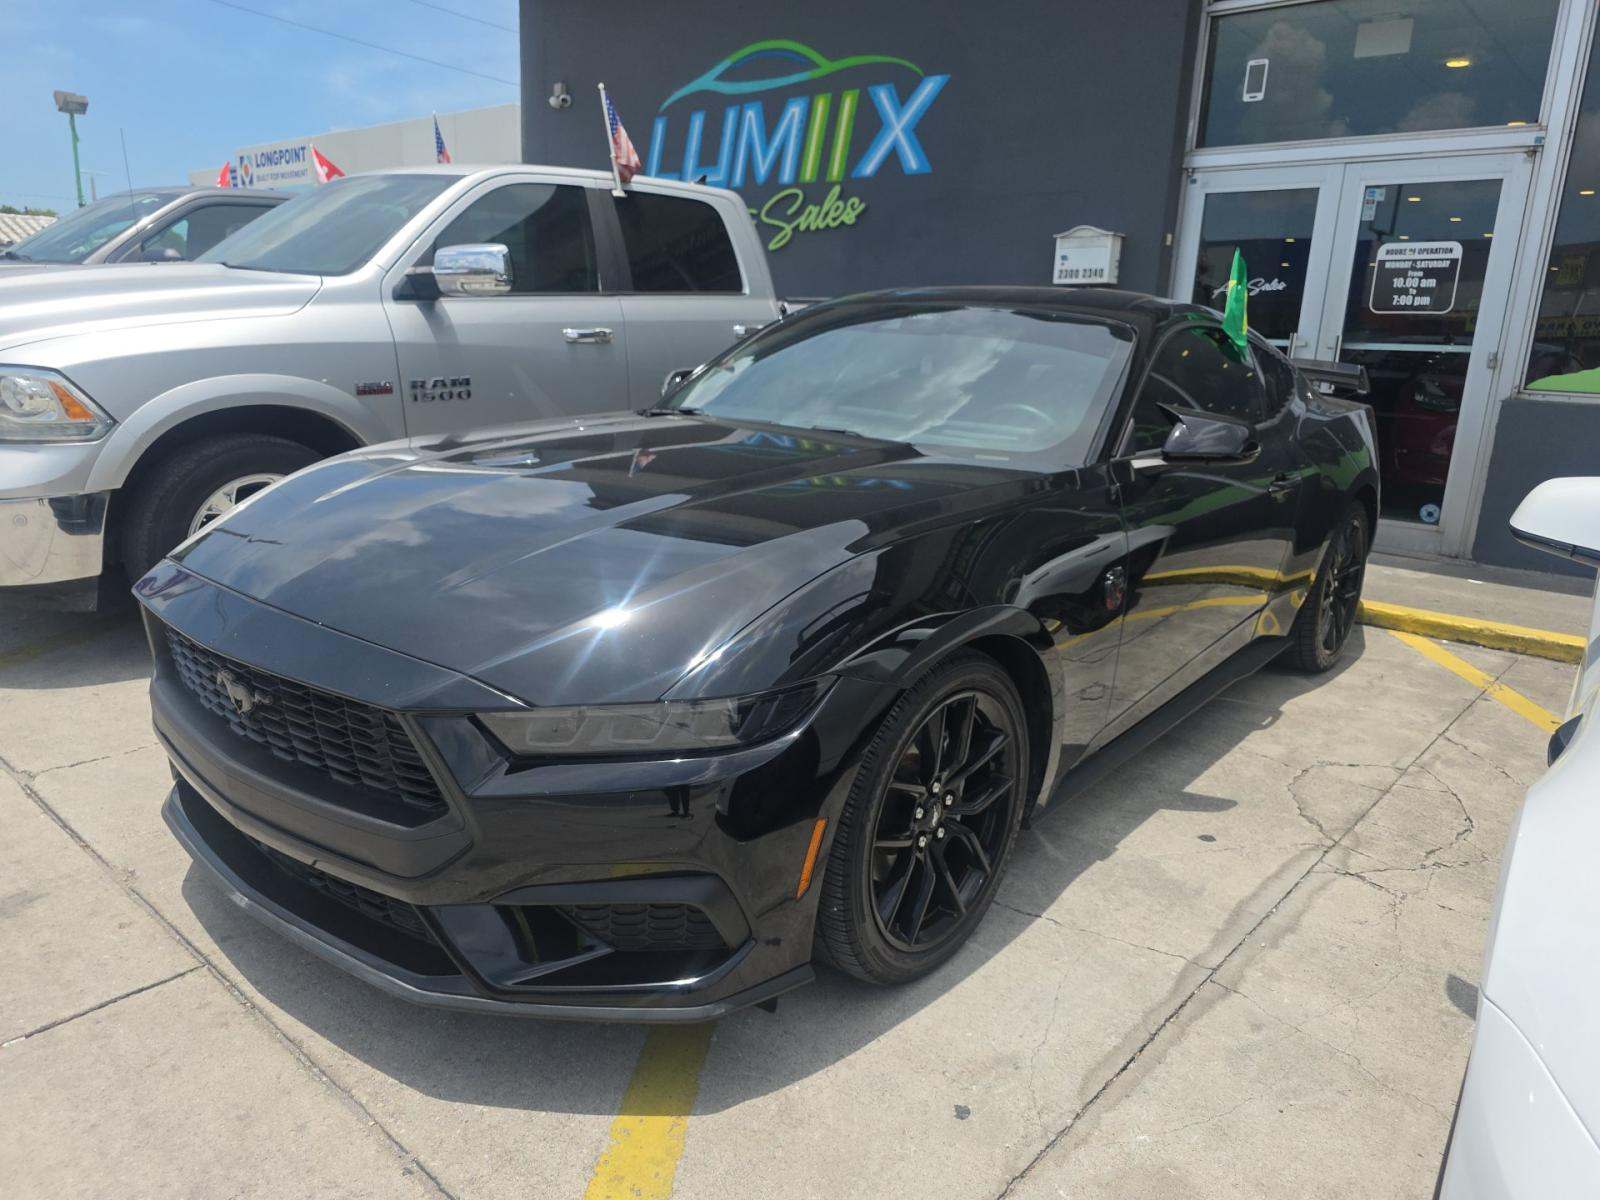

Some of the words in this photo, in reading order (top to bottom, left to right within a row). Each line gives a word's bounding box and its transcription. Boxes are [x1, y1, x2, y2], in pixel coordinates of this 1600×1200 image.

[255, 146, 306, 168] LONGPOINT
[760, 185, 866, 251] Sales
[1385, 261, 1412, 269] MONDAY
[1416, 260, 1450, 268] SATURDAY
[1420, 278, 1436, 288] am
[1392, 295, 1413, 306] 7:00
[1413, 296, 1431, 306] pm
[411, 378, 471, 389] RAM
[411, 390, 471, 402] 1500
